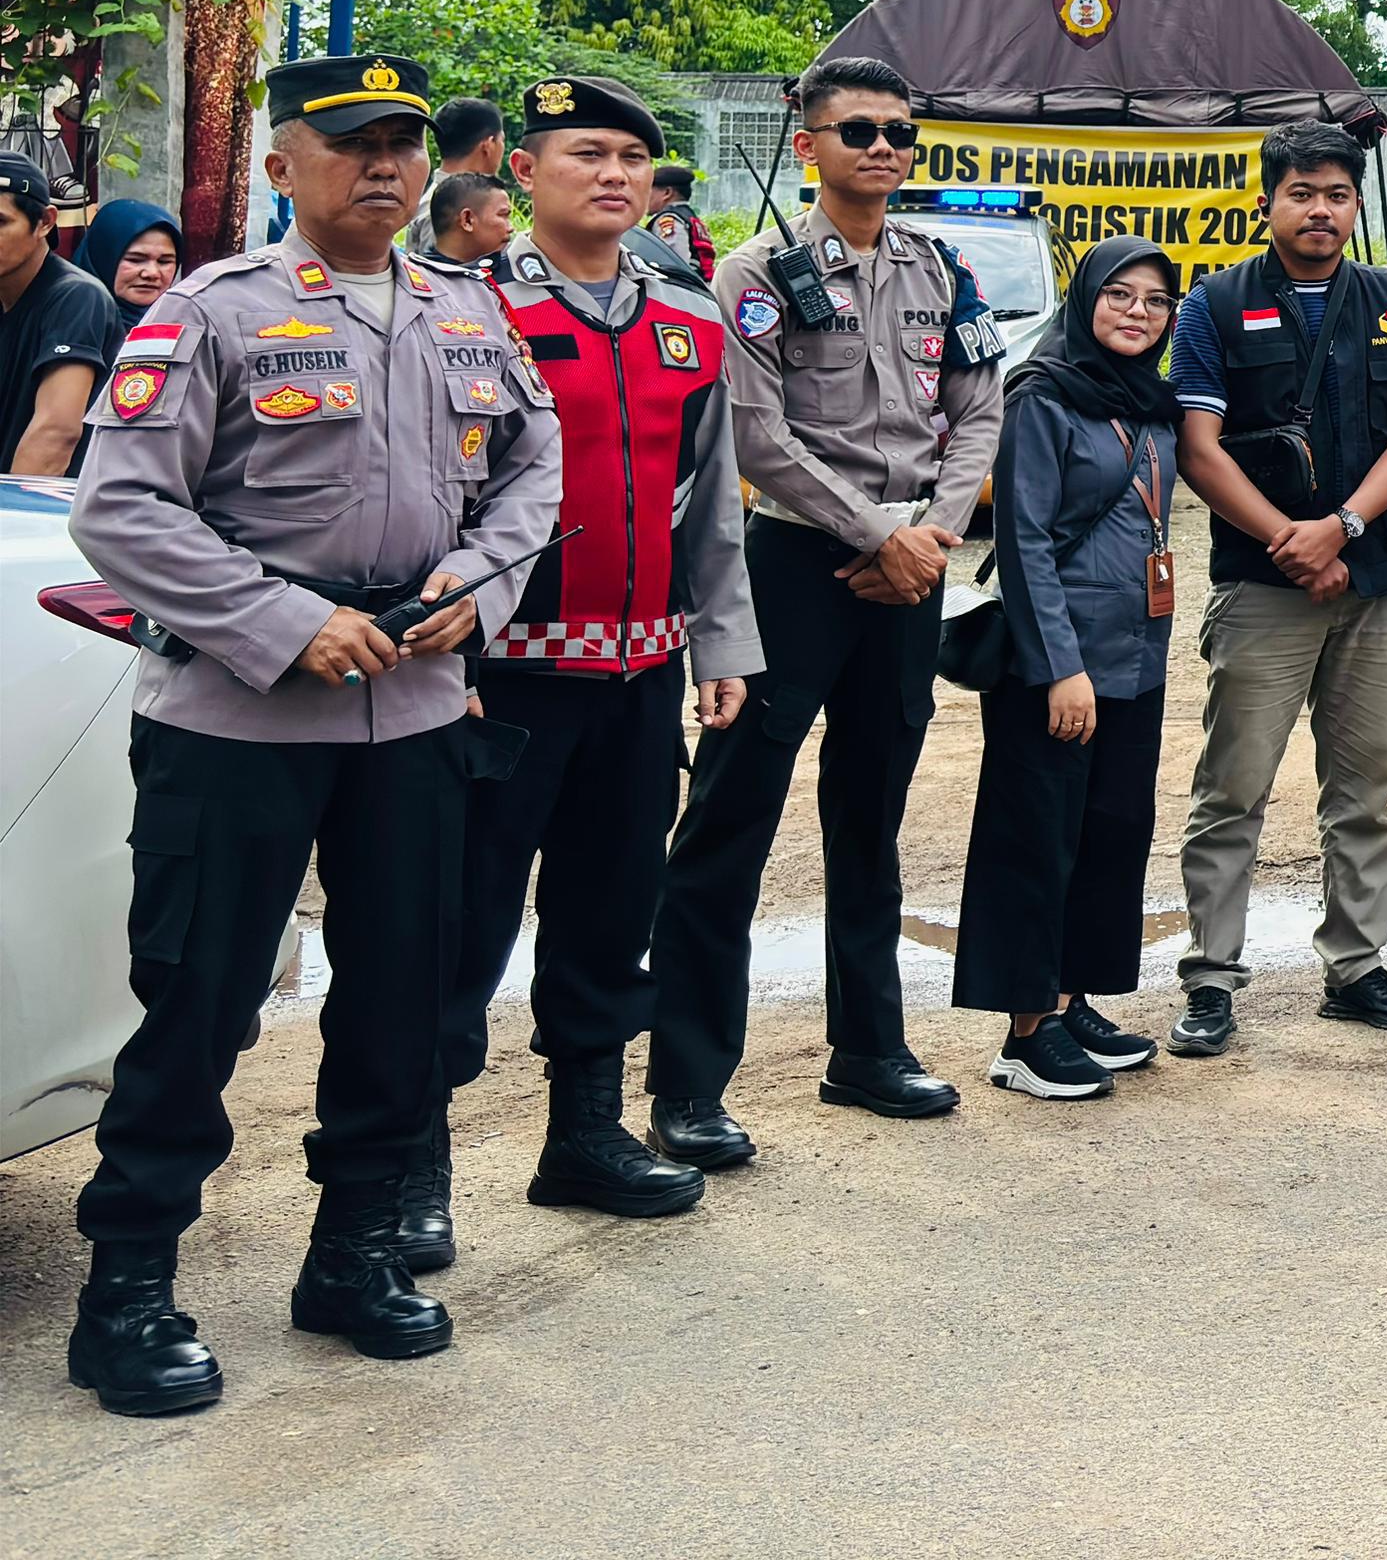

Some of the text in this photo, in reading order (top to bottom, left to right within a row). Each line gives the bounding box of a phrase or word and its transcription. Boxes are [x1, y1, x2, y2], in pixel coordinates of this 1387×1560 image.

[910, 143, 1248, 190] POS PENGAMANAN
[1036, 203, 1272, 245] OGISTIK 202
[903, 311, 949, 327] POLR
[955, 309, 1005, 364] PAT
[255, 350, 348, 377] G.HUSEIN
